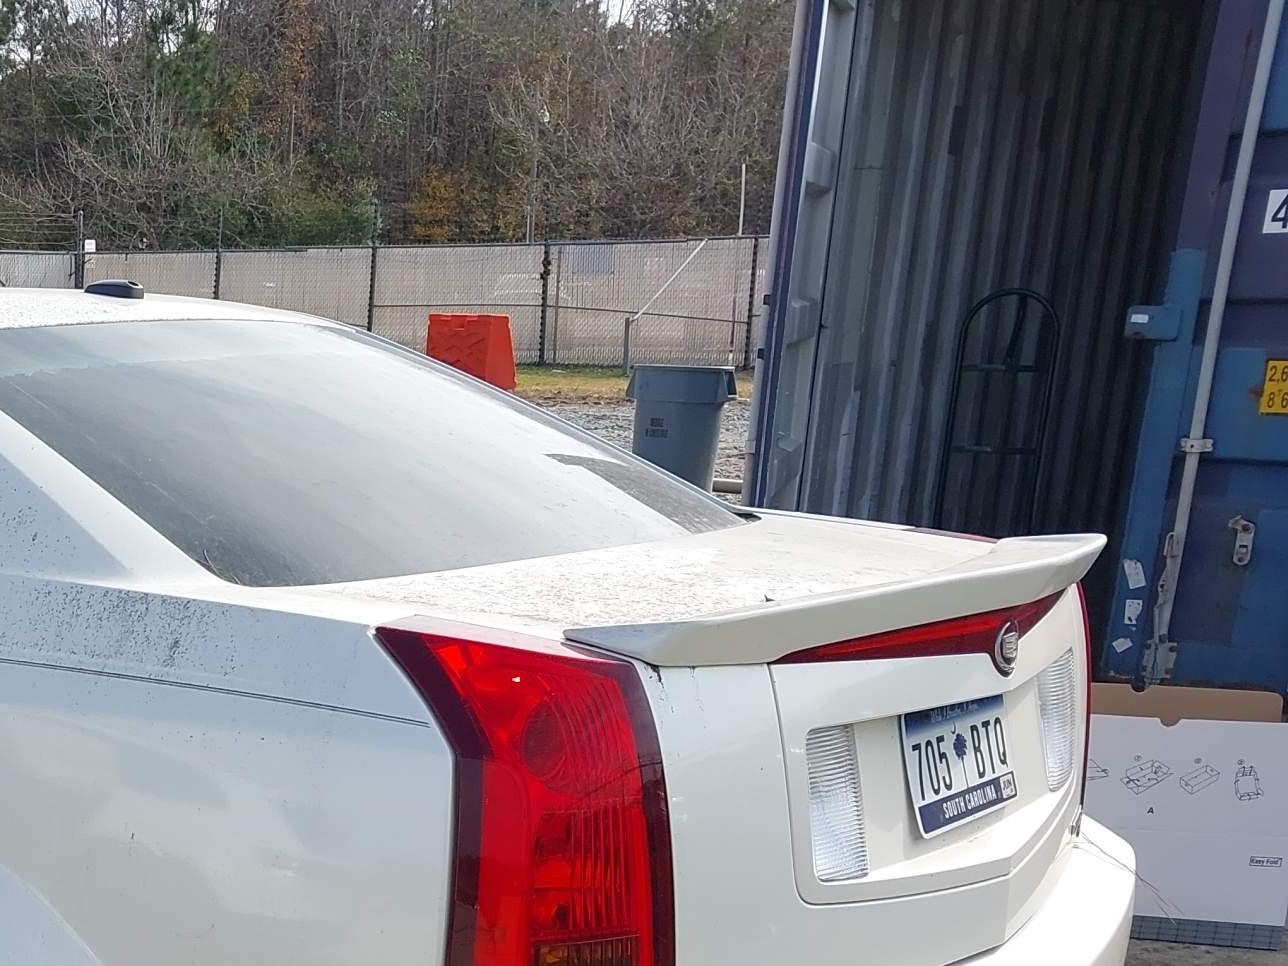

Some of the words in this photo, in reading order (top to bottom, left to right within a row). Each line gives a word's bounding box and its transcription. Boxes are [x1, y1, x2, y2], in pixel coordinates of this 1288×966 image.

[912, 735, 953, 801] 705
[970, 717, 1009, 779] BTQ
[943, 797, 966, 818] SOUTH
[965, 784, 997, 809] CAROLINA
